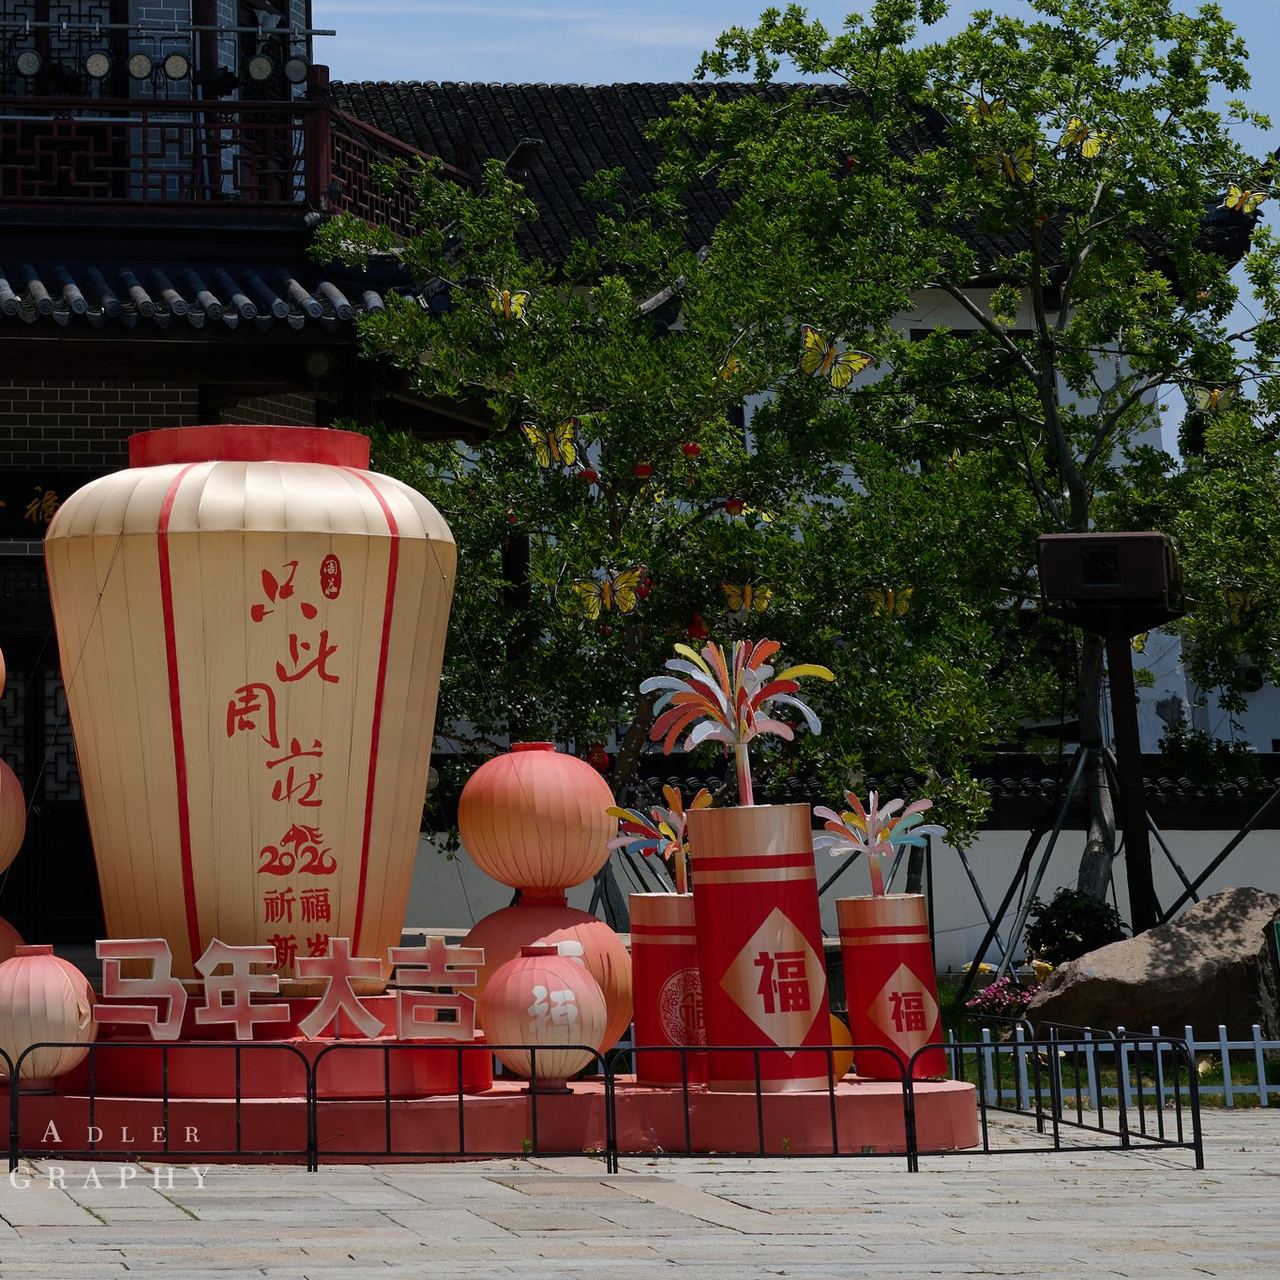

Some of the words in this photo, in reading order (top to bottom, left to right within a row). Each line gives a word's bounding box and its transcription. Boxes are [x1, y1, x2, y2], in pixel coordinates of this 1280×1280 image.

[256, 844, 338, 877] 2026
[263, 886, 332, 925] 祈福
[91, 935, 487, 1041] 马年大吉
[753, 950, 812, 1014] 福
[888, 991, 927, 1033] 福
